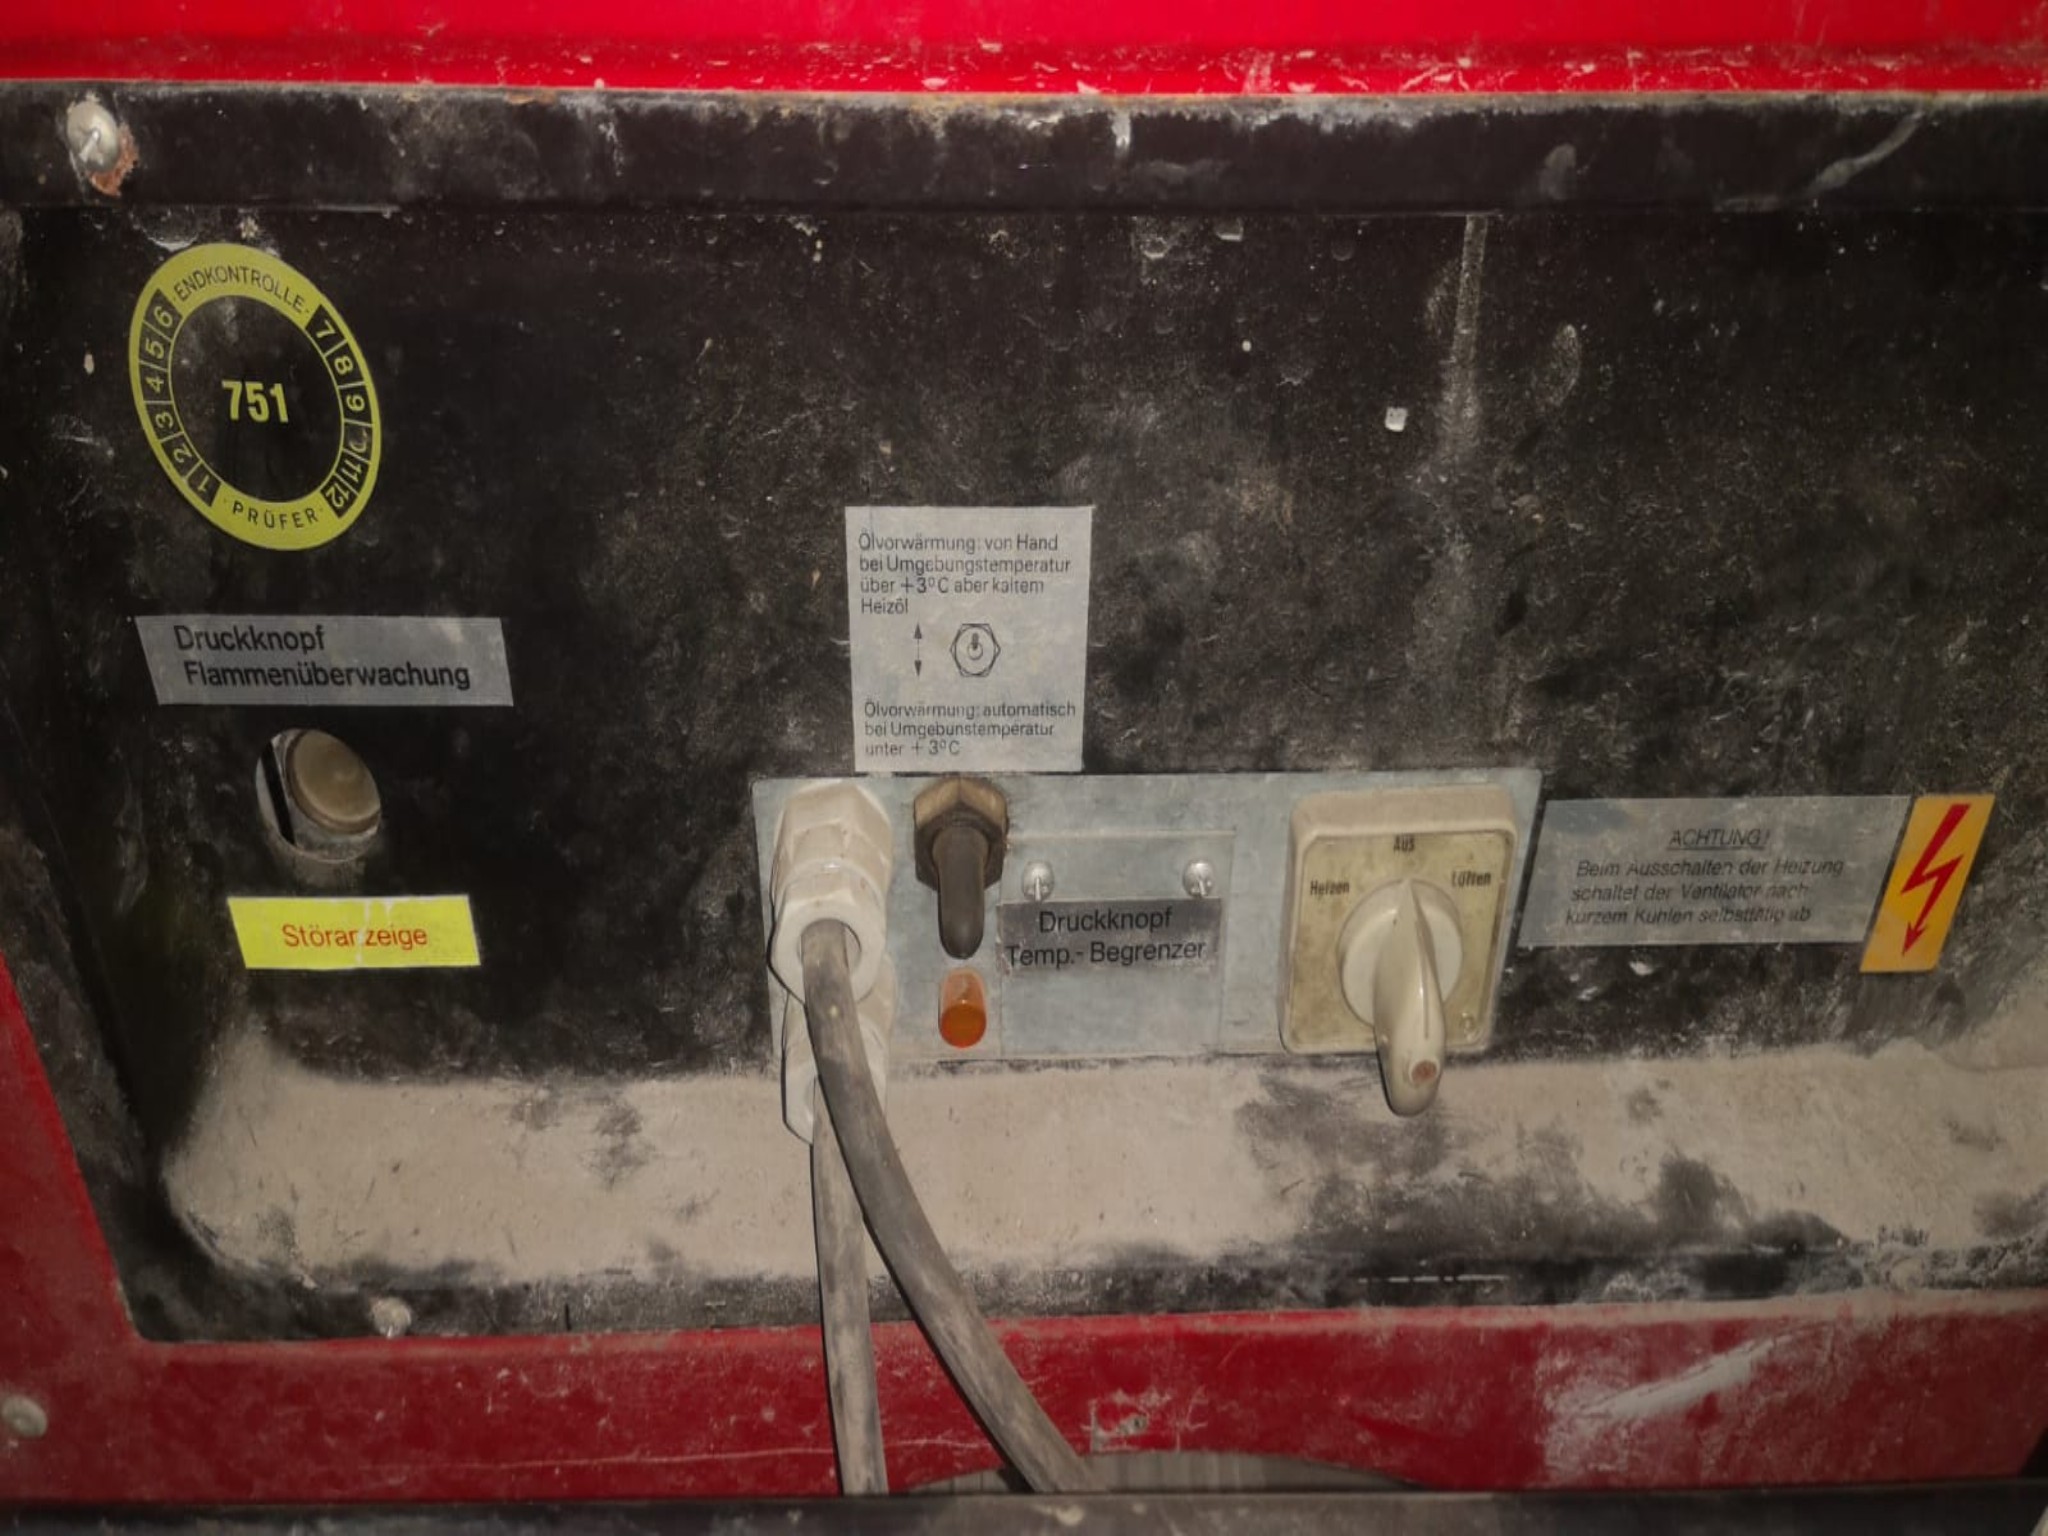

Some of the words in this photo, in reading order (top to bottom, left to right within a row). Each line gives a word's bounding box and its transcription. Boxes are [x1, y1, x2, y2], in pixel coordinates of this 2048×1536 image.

[173, 265, 305, 314] ENDKONTROLLE
[153, 306, 173, 327] 6
[314, 320, 335, 340] 7
[145, 339, 165, 359] 5
[334, 355, 354, 375] 8
[145, 375, 164, 393] 4
[221, 380, 289, 423] 751
[155, 411, 173, 429] 3
[173, 443, 193, 463] 2
[341, 459, 361, 483] 11
[325, 482, 350, 509] 12
[232, 500, 318, 530] PRÜFER
[984, 537, 1012, 551] von
[1016, 533, 1058, 551] Hand
[859, 555, 883, 572] bei
[887, 555, 1070, 576] Umgebungstemperatur
[860, 577, 896, 593] über
[954, 577, 988, 593] aber
[992, 577, 1044, 594] kaltem
[861, 597, 909, 615] Heizöl
[173, 625, 325, 654] Druckknopf
[184, 661, 471, 691] Flammenüberwachung
[983, 700, 1076, 717] automatisch
[864, 721, 887, 736] bei
[890, 721, 1055, 741] Umgebunstemperatur
[865, 742, 904, 756] unter
[1393, 834, 1416, 852] Aus
[1668, 828, 1770, 849] ACHTUNG!
[1576, 860, 1620, 877] Beim
[1626, 858, 1733, 876] Ausschalten
[1740, 858, 1769, 875] der
[1773, 858, 1843, 878] Heizung
[1310, 880, 1350, 895] Heizen
[1571, 883, 1639, 901] schaltet
[1644, 882, 1673, 900] der
[1682, 882, 1762, 900] Ventilator
[1039, 906, 1173, 933] Druckknopf
[1566, 907, 1628, 925] kurzem
[1090, 941, 1207, 966] Begrenzer
